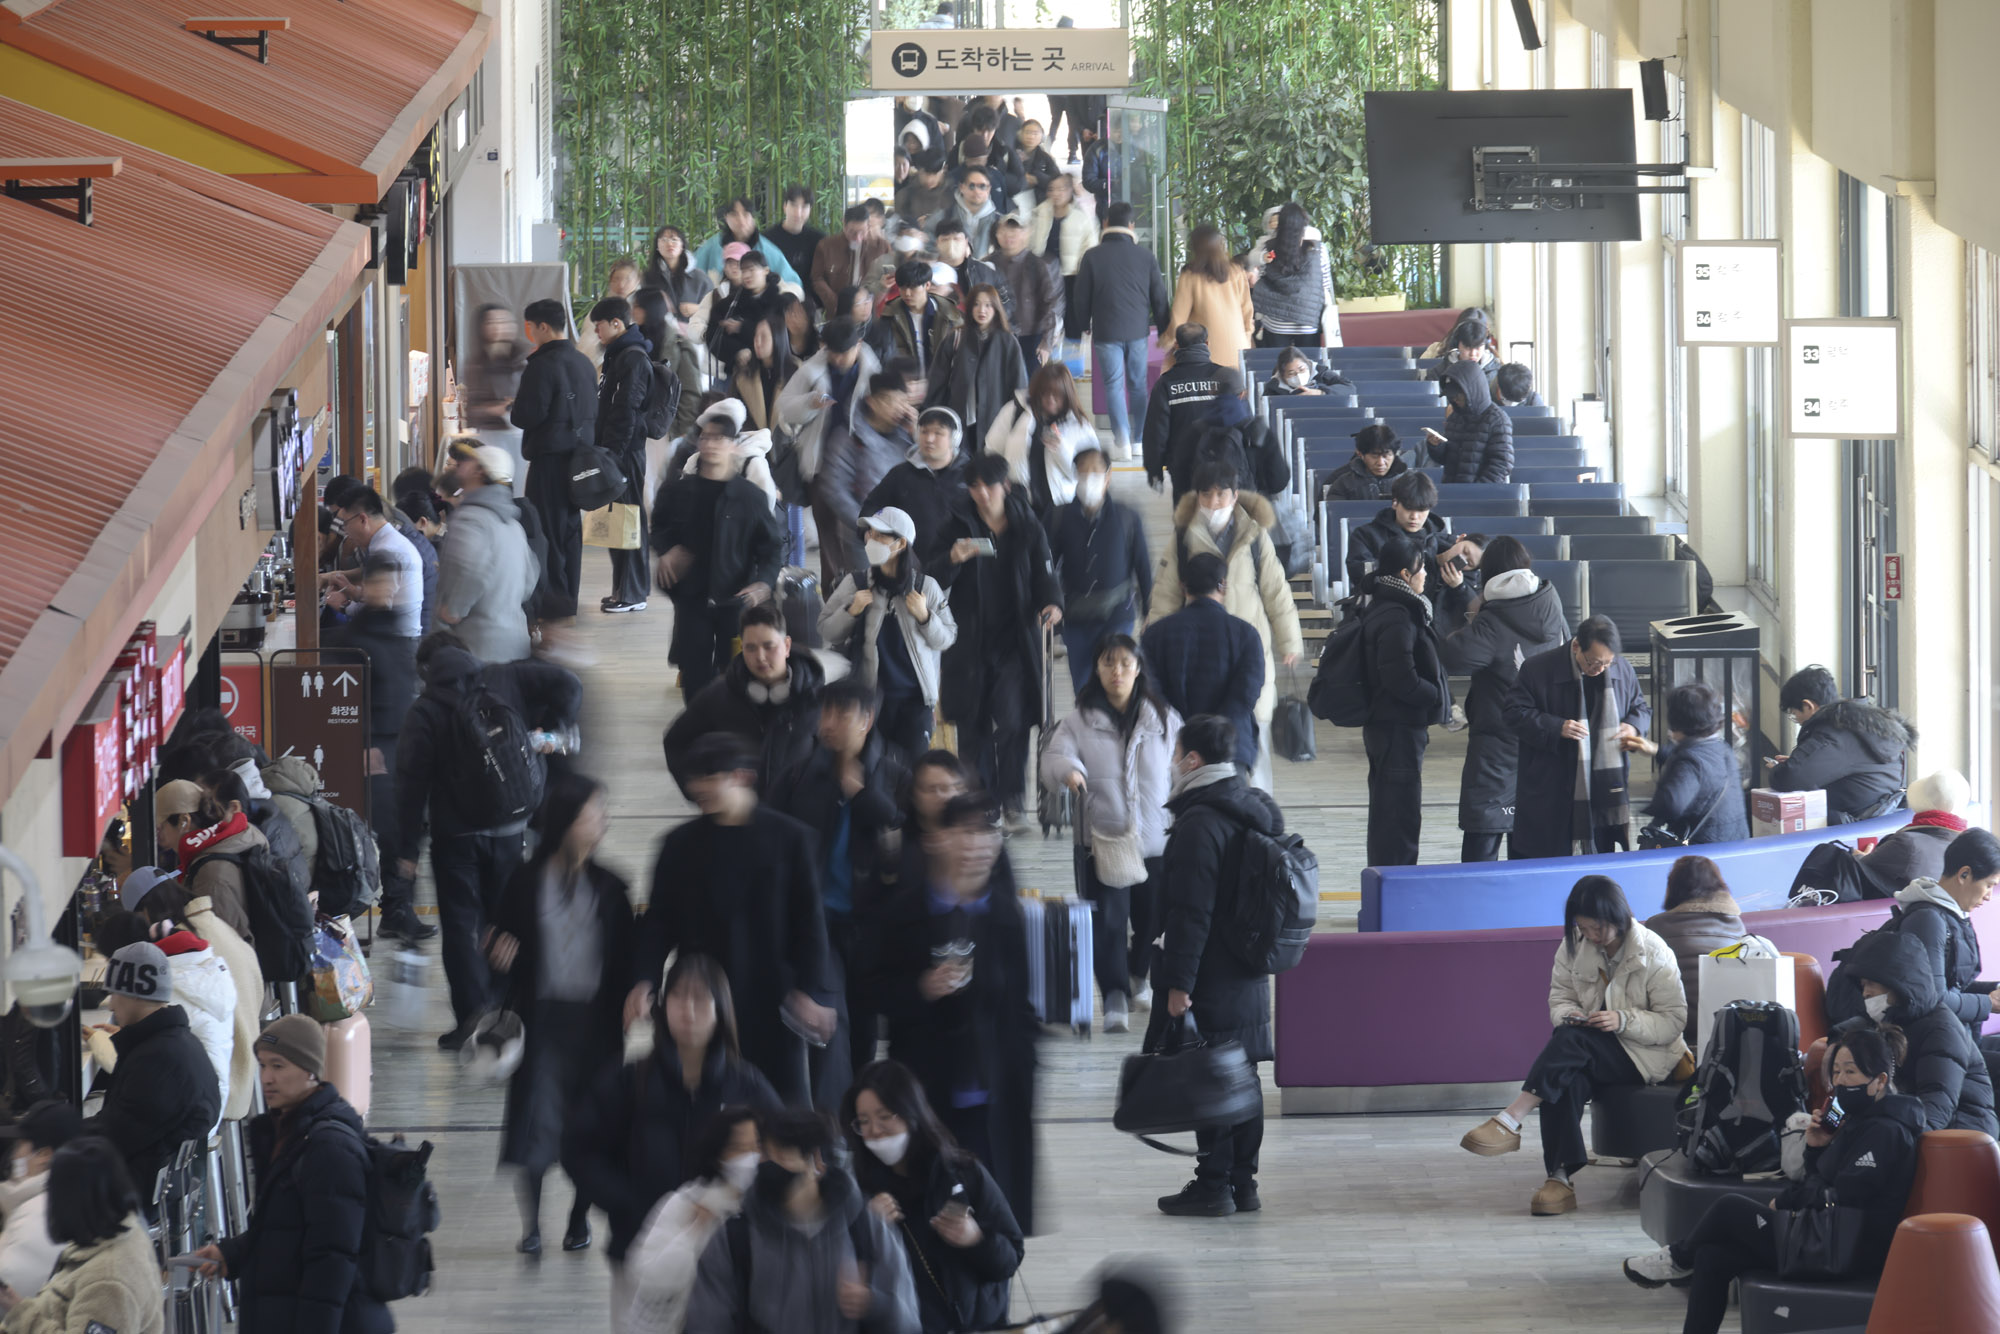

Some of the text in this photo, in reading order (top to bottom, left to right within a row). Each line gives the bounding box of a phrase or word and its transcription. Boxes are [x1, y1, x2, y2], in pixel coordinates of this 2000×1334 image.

[935, 46, 1116, 72] 도착하는 곳 ARRIVAL
[1696, 266, 1710, 278] 35
[1697, 313, 1711, 325] 36
[1803, 348, 1819, 361] 33
[1170, 381, 1220, 395] SECURIT
[1804, 401, 1820, 414] 34
[331, 705, 359, 716] 화장실
